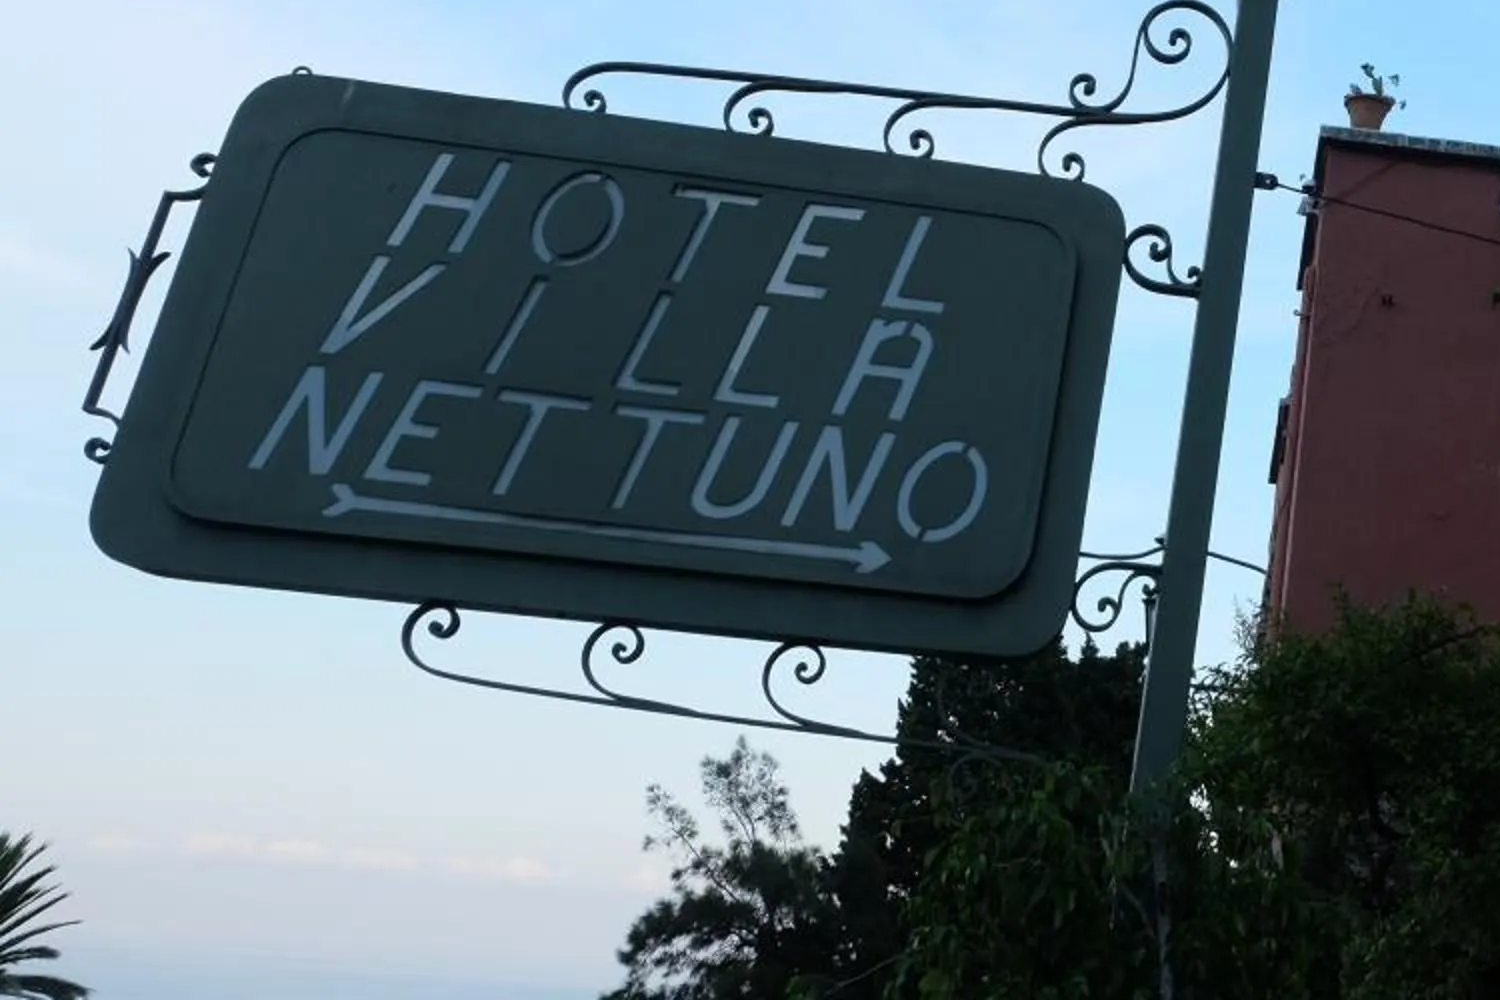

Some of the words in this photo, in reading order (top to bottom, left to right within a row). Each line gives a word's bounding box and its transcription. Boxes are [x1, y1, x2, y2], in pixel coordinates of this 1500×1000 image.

[386, 153, 945, 313] HOTEL
[321, 255, 933, 419] VILLA
[250, 365, 987, 543] NETTUNO
